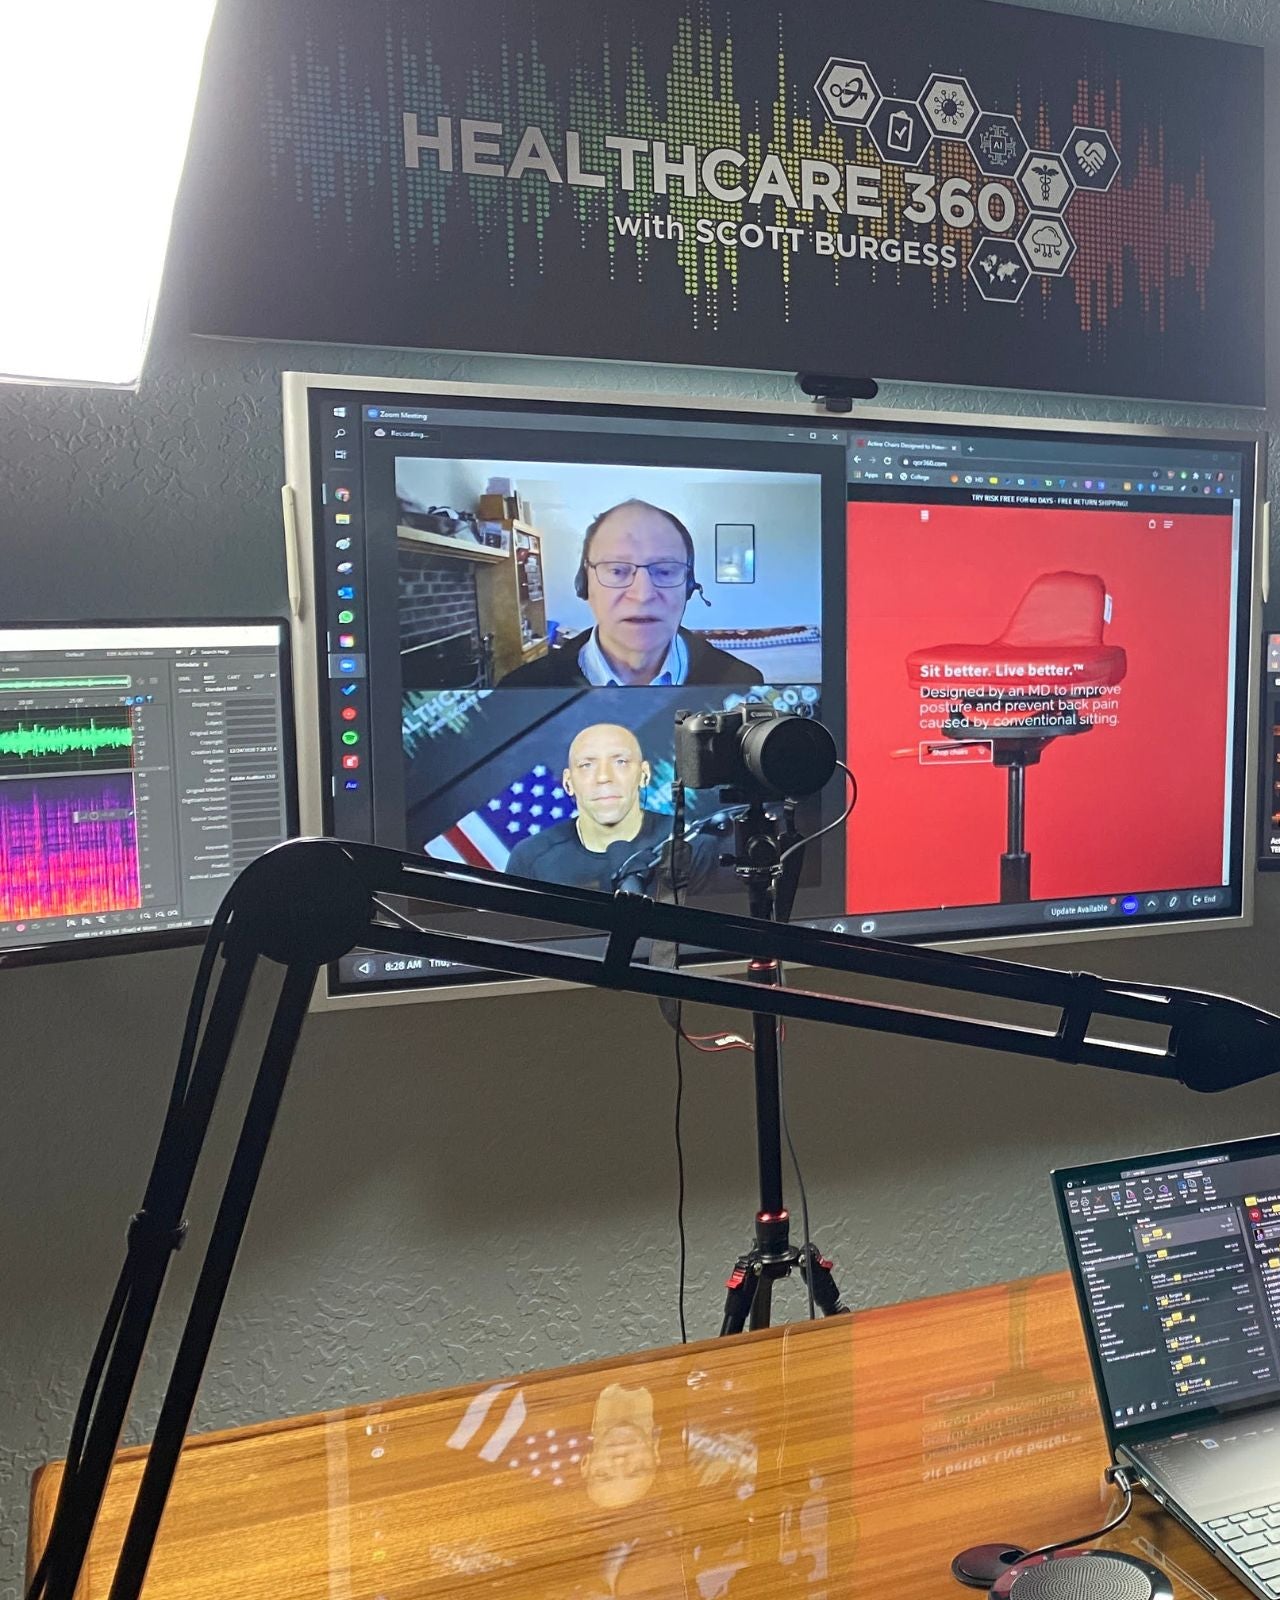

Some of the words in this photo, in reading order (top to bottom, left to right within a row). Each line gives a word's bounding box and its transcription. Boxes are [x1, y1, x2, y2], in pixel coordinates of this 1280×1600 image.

[402, 112, 883, 217] HEALTHCARE
[902, 174, 1016, 233] 360
[614, 211, 685, 242] with
[695, 218, 804, 254] SCOTT
[814, 231, 957, 269] BURGESS
[401, 412, 428, 421] Meeting
[1016, 496, 1028, 504] FOR
[920, 665, 940, 677] Sit
[944, 664, 991, 677] better.
[996, 664, 1024, 676] Live
[920, 685, 984, 700] Designed
[989, 686, 1004, 699] by
[1008, 687, 1024, 697] an
[1029, 686, 1050, 696] MD
[1054, 686, 1067, 696] to
[1071, 685, 1121, 699] improve
[920, 702, 972, 716] posture
[976, 700, 1000, 712] and
[1005, 700, 1054, 714] prevent
[1059, 699, 1088, 710] back
[1093, 699, 1118, 713] pain
[920, 717, 969, 728] caused
[974, 716, 989, 730] by
[994, 714, 1076, 727] conventional
[1079, 714, 1120, 726] sitting.
[1051, 907, 1075, 917] Update
[1078, 905, 1107, 913] Available
[385, 962, 404, 971] 8:28
[407, 960, 421, 969] AM
